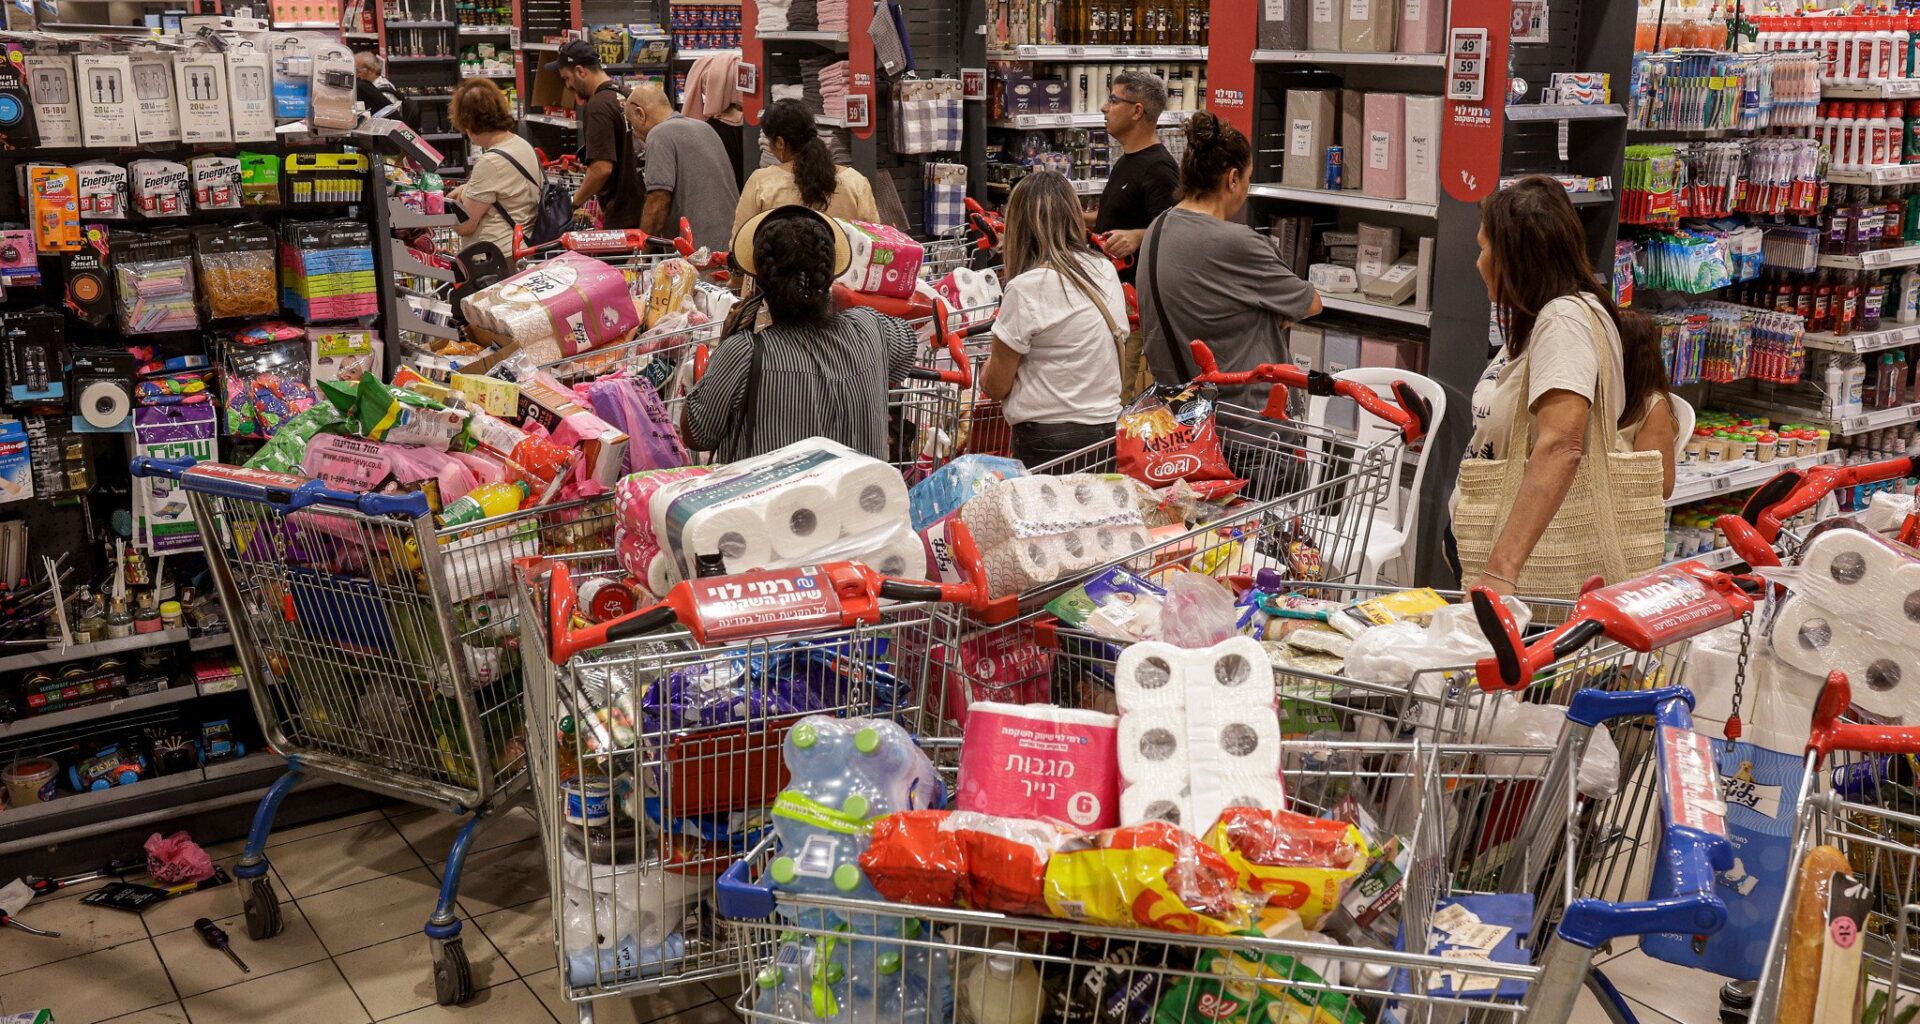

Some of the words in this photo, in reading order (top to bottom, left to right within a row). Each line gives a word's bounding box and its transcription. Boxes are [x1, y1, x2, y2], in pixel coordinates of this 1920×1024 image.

[1512, 9, 1524, 29] 8
[1462, 40, 1474, 52] 49
[1460, 61, 1473, 72] 59
[1459, 81, 1472, 92] 99
[849, 107, 858, 120] 59
[1455, 106, 1466, 115] לוי
[1468, 107, 1482, 115] רמי
[1330, 152, 1341, 164] XL
[198, 164, 238, 180] Energizer
[81, 172, 124, 187] Energizer
[145, 171, 185, 188] Energizer
[1142, 429, 1196, 453] CRISPY
[362, 444, 380, 454] הזול
[931, 536, 951, 572] Lily
[1720, 554, 1725, 562] 3
[707, 583, 742, 600] לוי
[748, 578, 793, 595] רמי
[1641, 582, 1679, 598] רמי
[778, 590, 822, 606] שיווק
[1616, 590, 1641, 603] לוי
[780, 608, 811, 619] הקניות
[815, 606, 827, 614] סל
[719, 616, 753, 627] במדינה
[756, 612, 776, 622] הזול
[1654, 617, 1678, 632] במדינה
[1002, 727, 1033, 738] השקמה
[1034, 731, 1053, 742] שיווק
[1055, 732, 1064, 742] לוי
[1065, 734, 1080, 744] רמי
[1005, 754, 1075, 778] מגבות
[1021, 779, 1056, 800] נייר
[1076, 796, 1092, 814] 6
